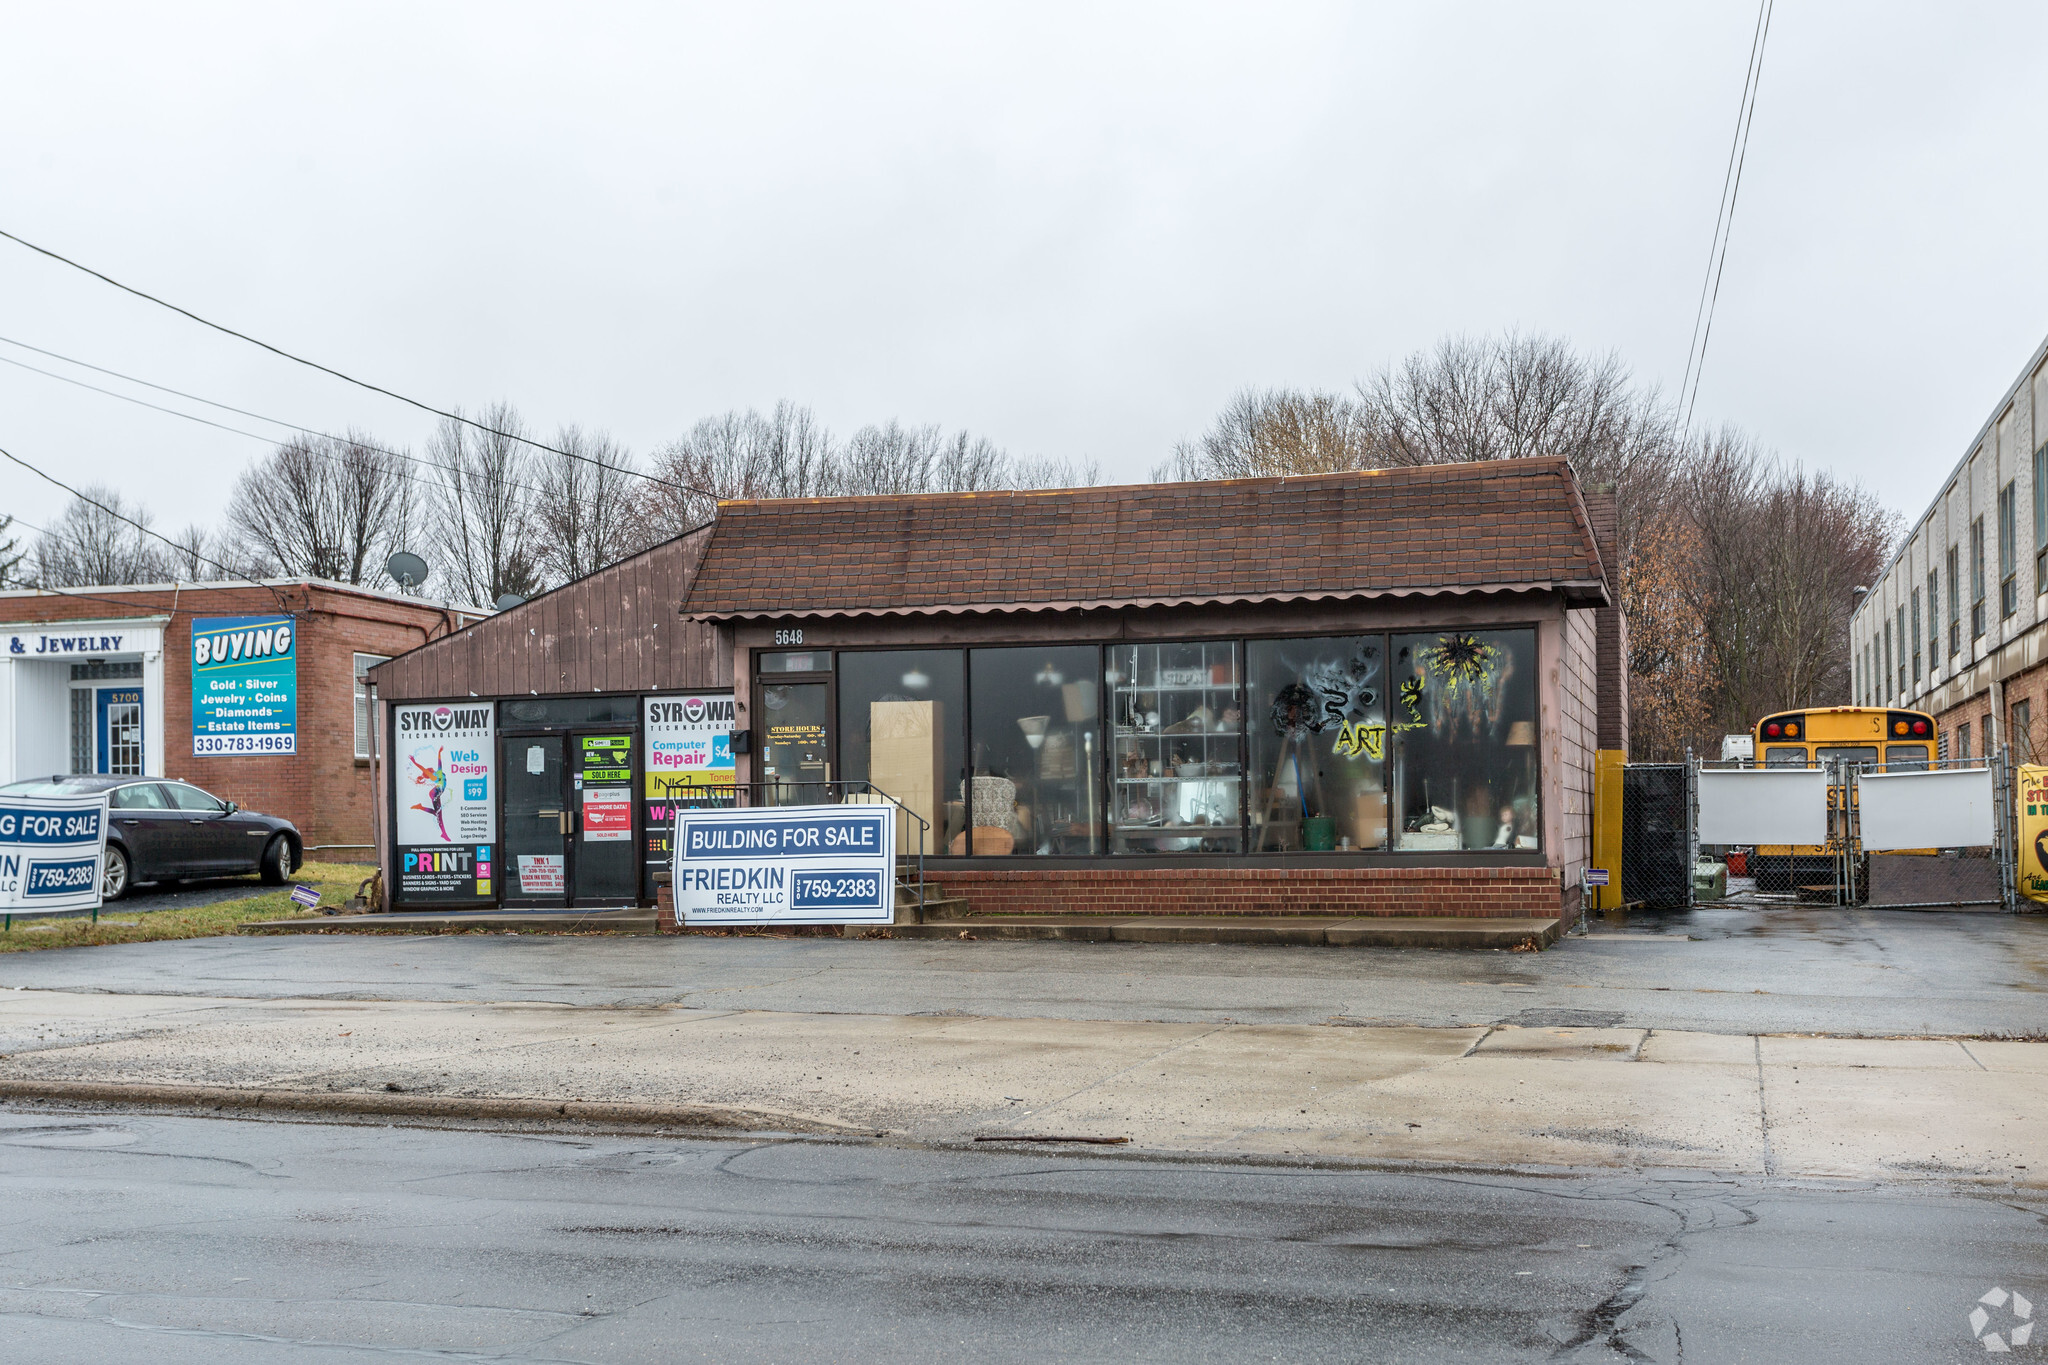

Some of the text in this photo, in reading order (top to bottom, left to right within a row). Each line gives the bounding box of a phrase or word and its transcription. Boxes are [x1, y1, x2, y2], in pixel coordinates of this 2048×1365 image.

[775, 629, 803, 645] 5648
[10, 636, 123, 654] & JEWELRY
[194, 626, 292, 665] BUYING
[210, 679, 278, 690] Gold Silver
[112, 692, 139, 704] 5700
[201, 693, 287, 705] Jewelry Coins
[215, 707, 273, 717] Diamonds
[650, 699, 735, 723] SYROWA
[208, 721, 280, 731] Estate Items
[402, 731, 489, 739] TECHNOLOGIES
[1335, 722, 1387, 760] ART
[196, 736, 292, 751] 330-783-1969
[652, 741, 706, 751] Computer
[450, 750, 479, 762] Web
[653, 750, 706, 768] Repair
[715, 744, 735, 759] $4
[450, 764, 488, 775] Design
[468, 788, 482, 796] $99
[2027, 804, 2037, 815] IN
[21, 816, 62, 836] FOR
[65, 815, 98, 836] SALE
[692, 829, 777, 850] BUILDING
[783, 828, 819, 847] FOR
[824, 827, 874, 846] SALE
[404, 852, 472, 872] PRINT
[38, 866, 93, 887] 759-2383
[683, 867, 784, 891] FRIEDKIN
[0, 880, 17, 892] LC
[803, 879, 876, 898] 759-2383
[717, 892, 784, 904] REALTY LLC
